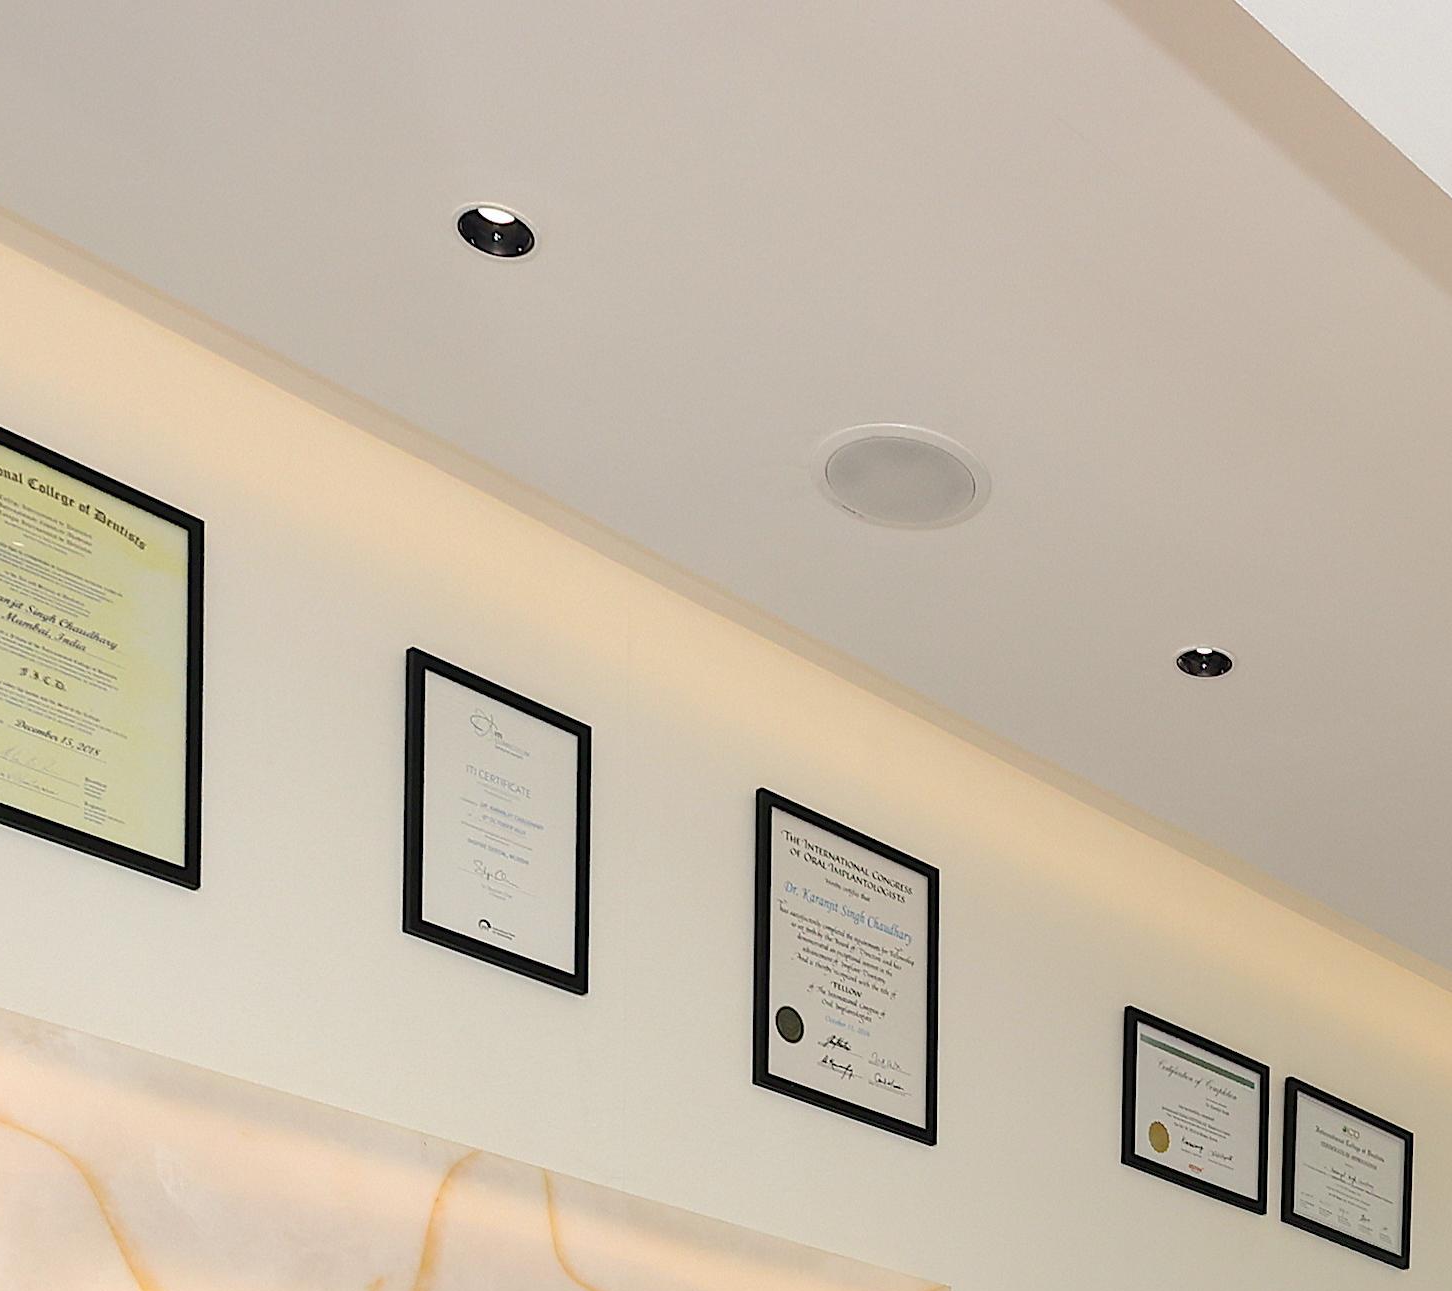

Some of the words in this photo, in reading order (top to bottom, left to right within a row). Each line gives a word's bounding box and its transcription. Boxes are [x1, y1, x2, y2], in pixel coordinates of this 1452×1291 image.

[27, 477, 75, 508] College
[79, 503, 91, 515] of
[94, 507, 147, 550] Dentists
[802, 839, 869, 876] INTERNATIONAL
[872, 870, 913, 895] CONGRESS
